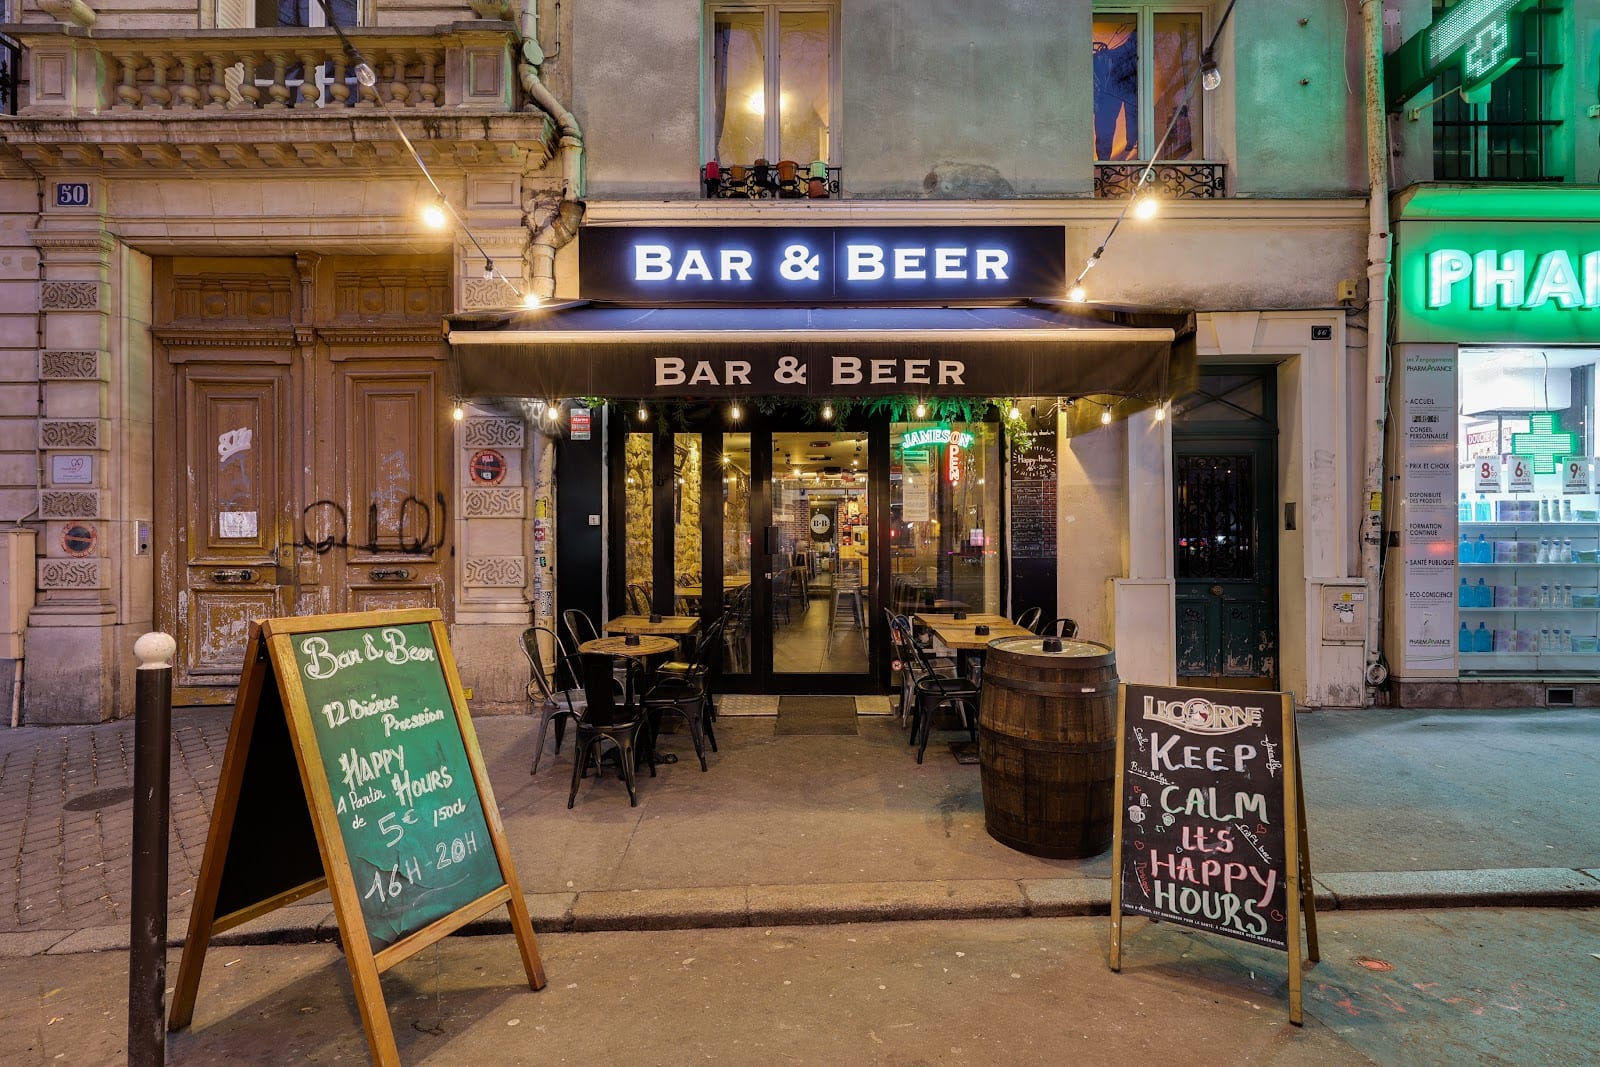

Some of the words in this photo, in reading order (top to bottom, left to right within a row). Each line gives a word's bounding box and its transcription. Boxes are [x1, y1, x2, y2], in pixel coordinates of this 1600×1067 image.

[61, 185, 84, 203] 50
[635, 245, 753, 281] BAR
[779, 245, 819, 281] &
[847, 245, 1009, 281] BEER
[654, 357, 752, 387] BAR
[773, 355, 807, 386] &
[831, 355, 966, 386] BEER
[902, 429, 974, 449] JAMESON
[322, 701, 350, 729] 12
[1142, 695, 1265, 730] LICORNE
[1150, 732, 1257, 773] KEEP
[1160, 785, 1271, 825] CALM
[352, 814, 367, 830] de
[1153, 879, 1268, 936] HOURS
